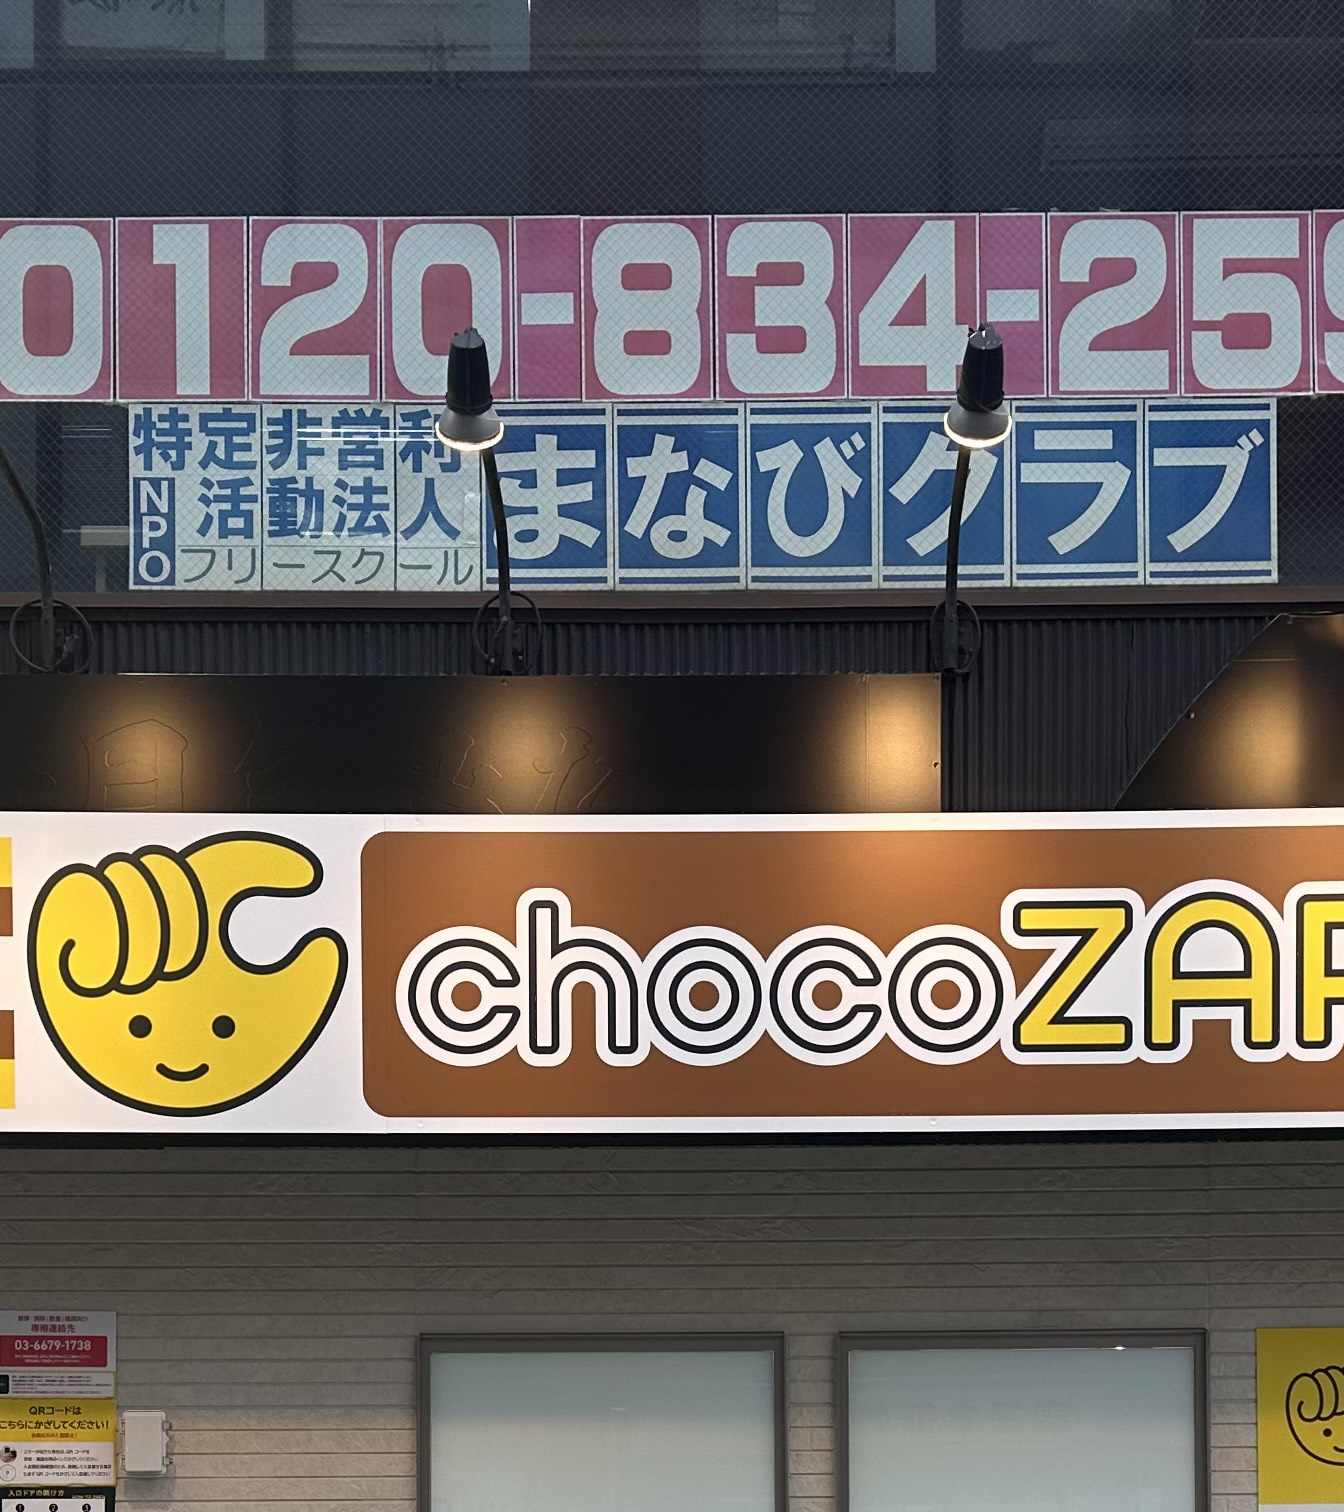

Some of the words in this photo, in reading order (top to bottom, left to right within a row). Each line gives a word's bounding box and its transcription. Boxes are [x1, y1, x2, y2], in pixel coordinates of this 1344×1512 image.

[133, 407, 459, 472] 特定非営利
[197, 477, 462, 540] 活動法人
[492, 427, 1265, 560] まなびクラブ
[139, 478, 172, 584] NPO
[180, 548, 474, 585] フリースクール
[14, 1339, 92, 1351] 03-6679-1738
